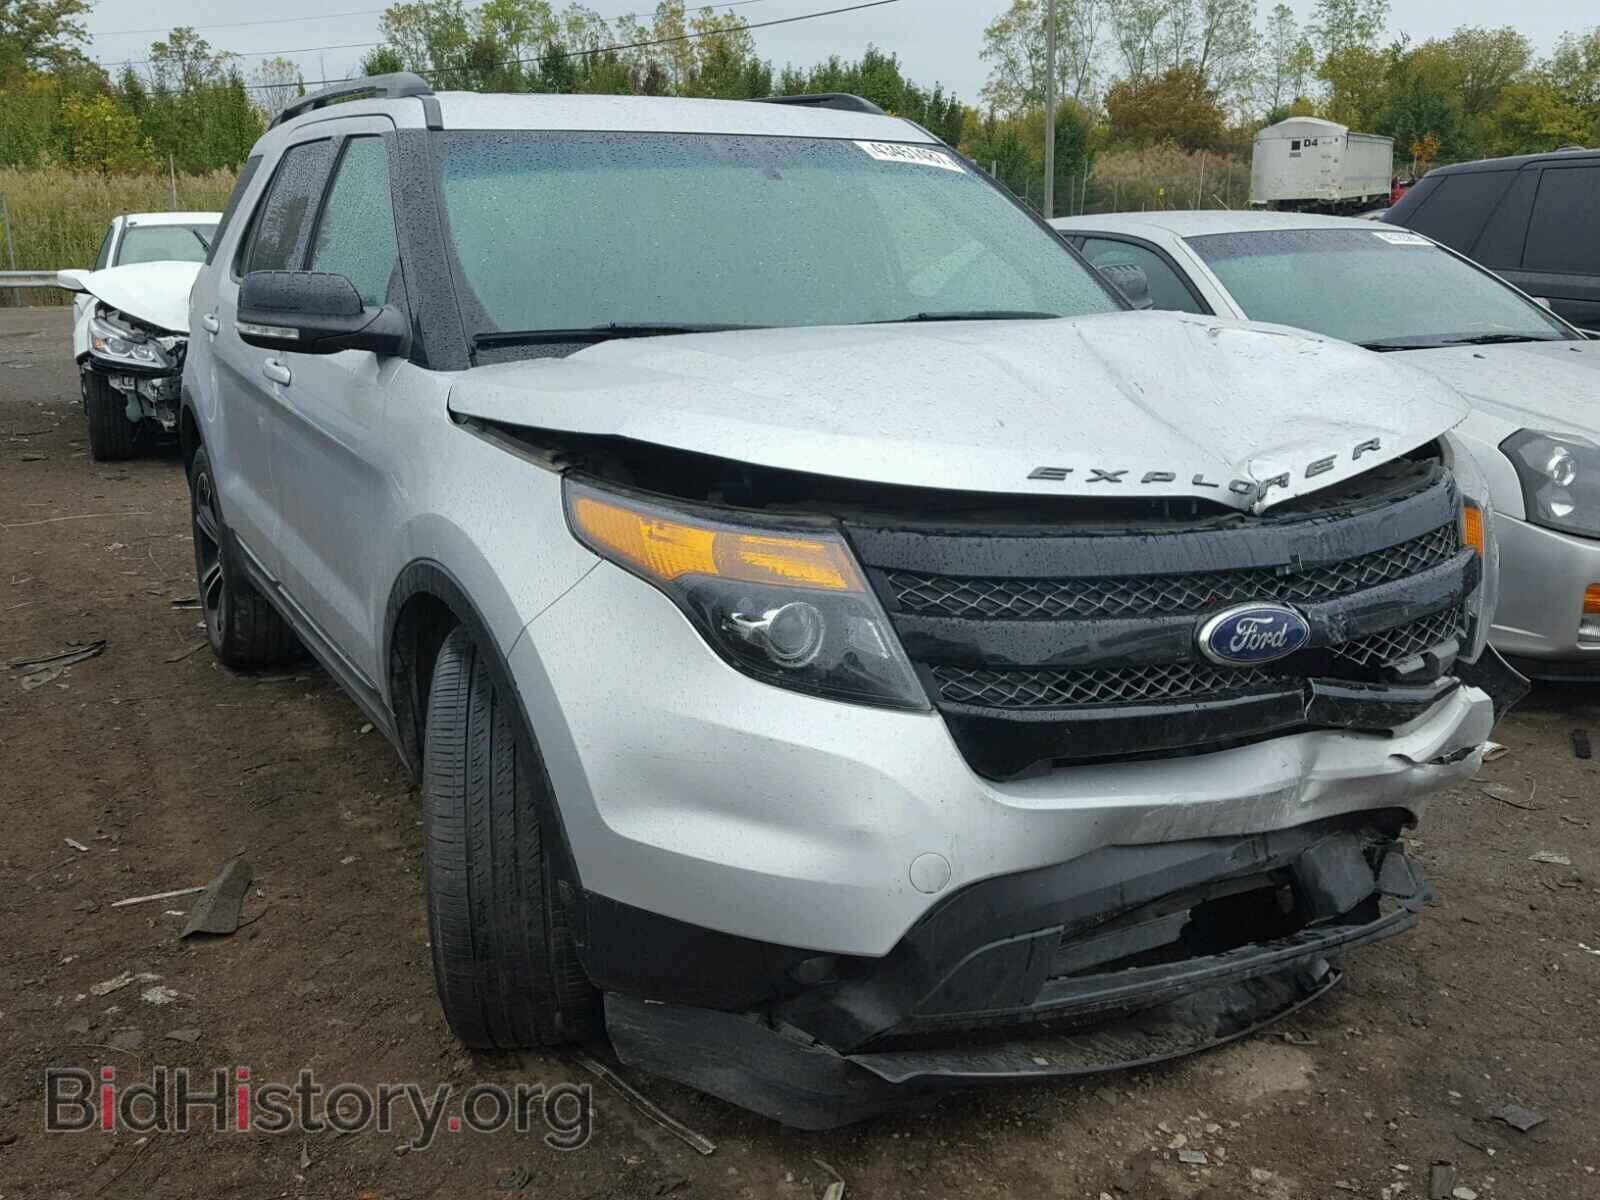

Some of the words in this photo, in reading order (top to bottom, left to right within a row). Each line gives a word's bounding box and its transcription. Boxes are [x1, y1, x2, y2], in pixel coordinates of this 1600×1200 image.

[1303, 139, 1318, 147] D4
[1027, 437, 1381, 499] EXPLORER
[1230, 617, 1288, 652] Ford
